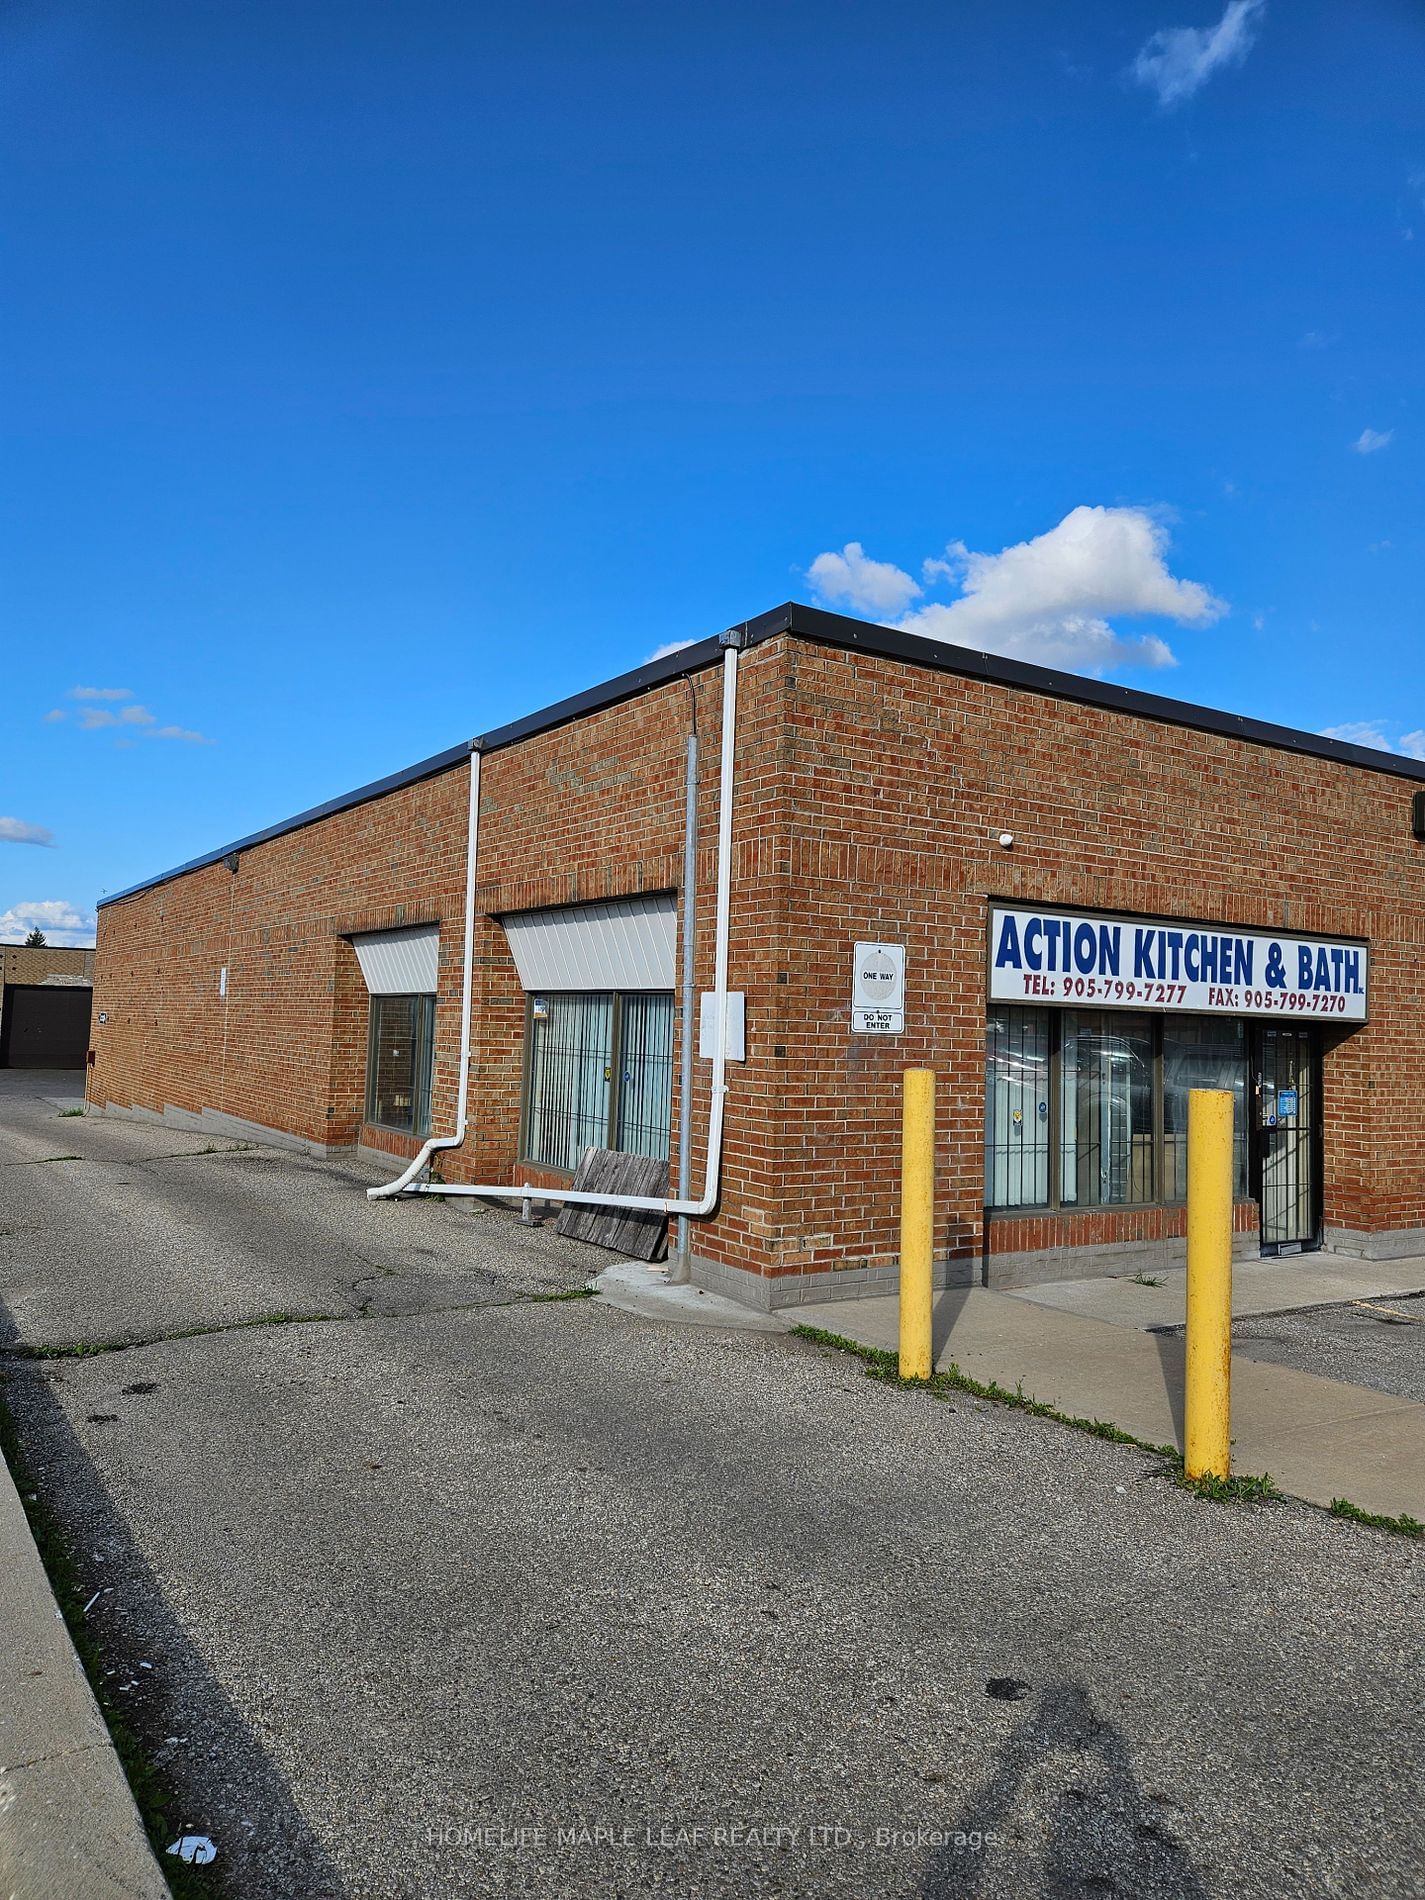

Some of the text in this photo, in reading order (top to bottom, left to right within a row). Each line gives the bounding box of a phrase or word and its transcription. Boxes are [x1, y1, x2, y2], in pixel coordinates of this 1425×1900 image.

[995, 915, 1359, 994] ACTION KITCHEN & BATH
[863, 971, 894, 981] ONE WAY
[1023, 974, 1187, 1004] TEL: 905-799-7277
[1208, 987, 1239, 1007] FAX:
[1244, 989, 1346, 1013] 905-799-7270
